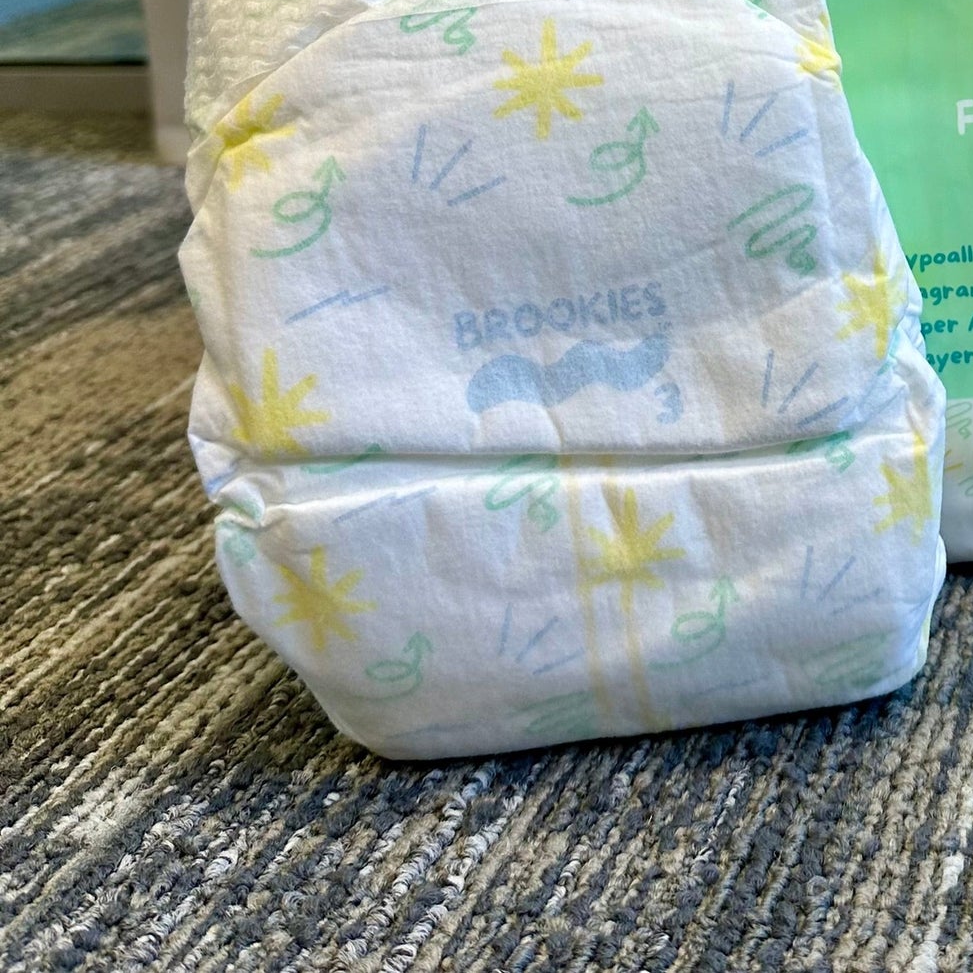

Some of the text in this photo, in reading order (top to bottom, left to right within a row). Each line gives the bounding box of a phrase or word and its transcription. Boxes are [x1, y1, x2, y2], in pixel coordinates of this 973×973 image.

[453, 280, 667, 351] BROOKIES
[920, 318, 959, 340] per
[653, 381, 684, 425] 3
